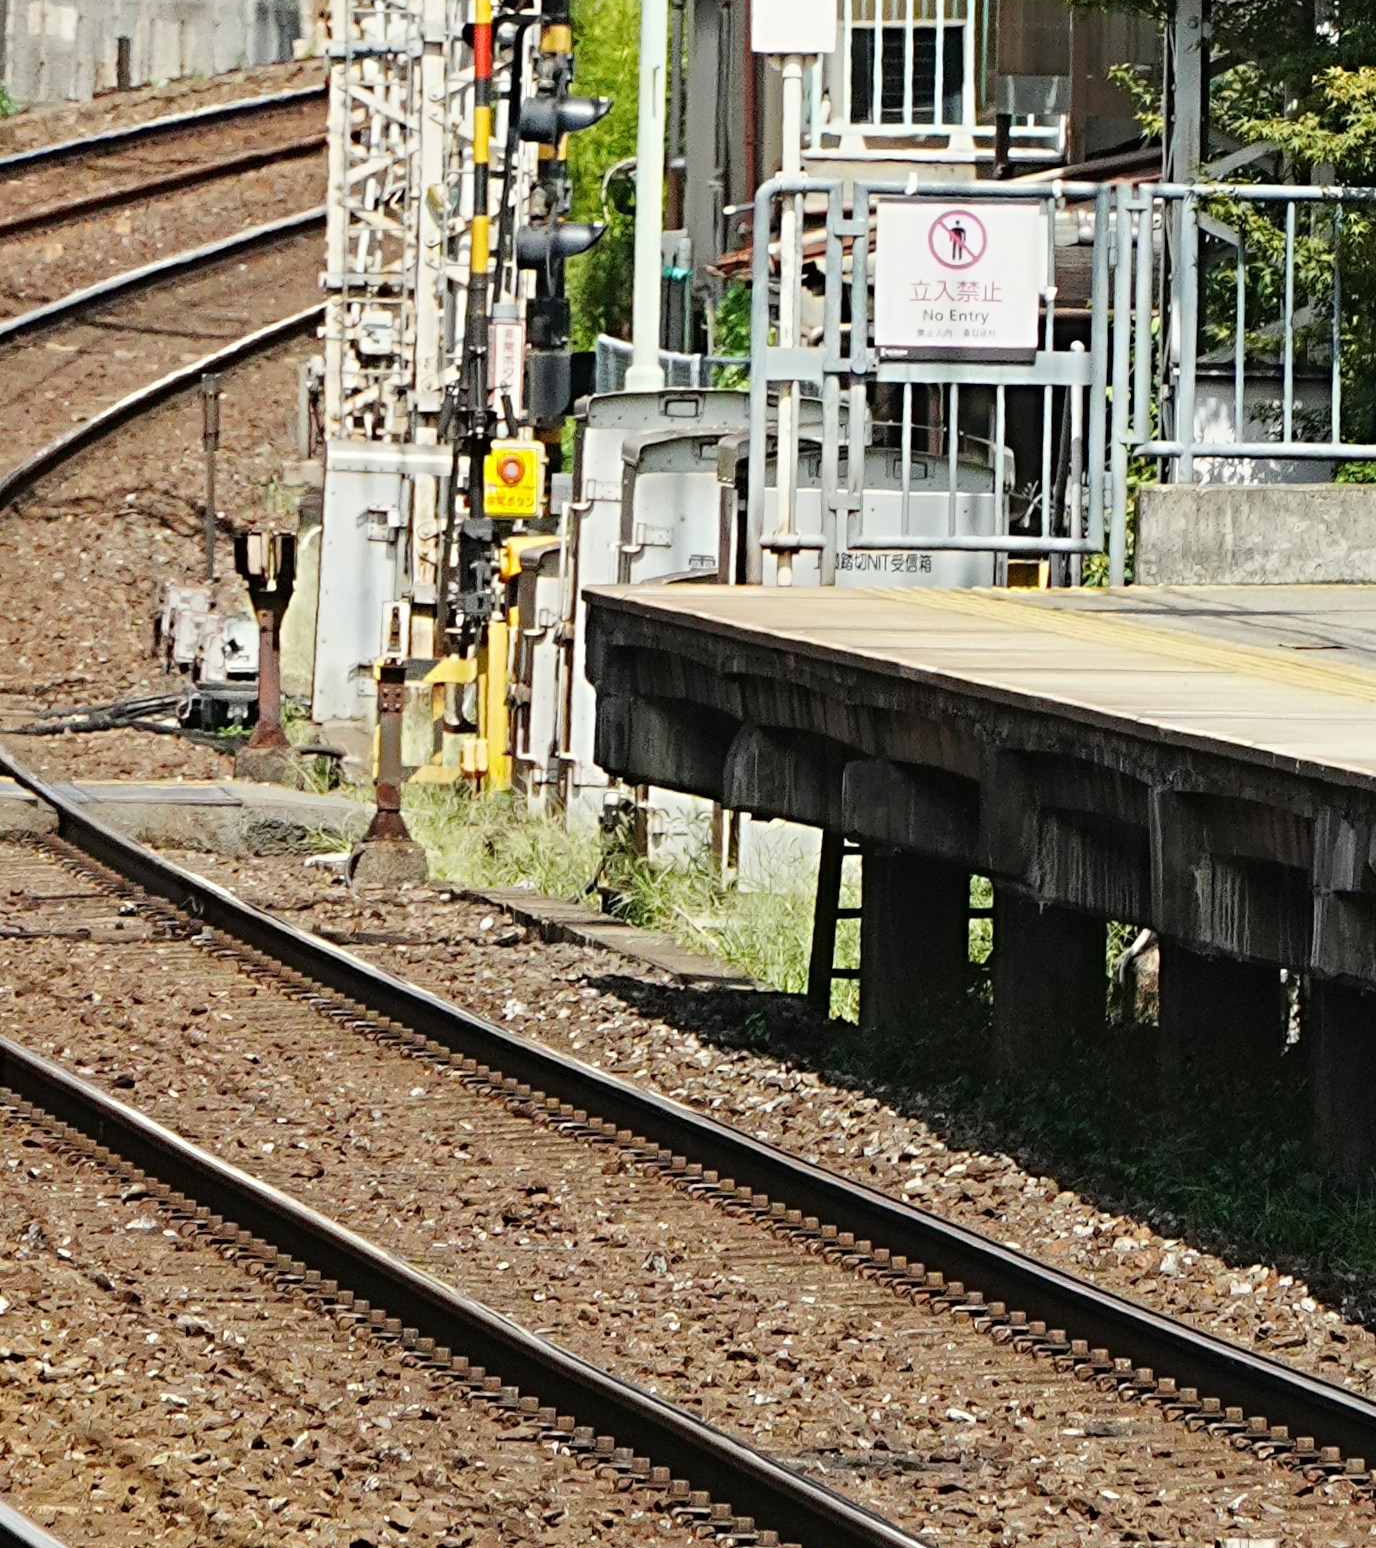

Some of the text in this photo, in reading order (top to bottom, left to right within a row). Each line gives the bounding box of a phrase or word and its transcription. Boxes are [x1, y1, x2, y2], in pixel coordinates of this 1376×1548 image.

[909, 280, 1003, 303] 立入禁止
[922, 309, 990, 325] No Entry
[814, 552, 933, 574] 踏切NIT受信箱
